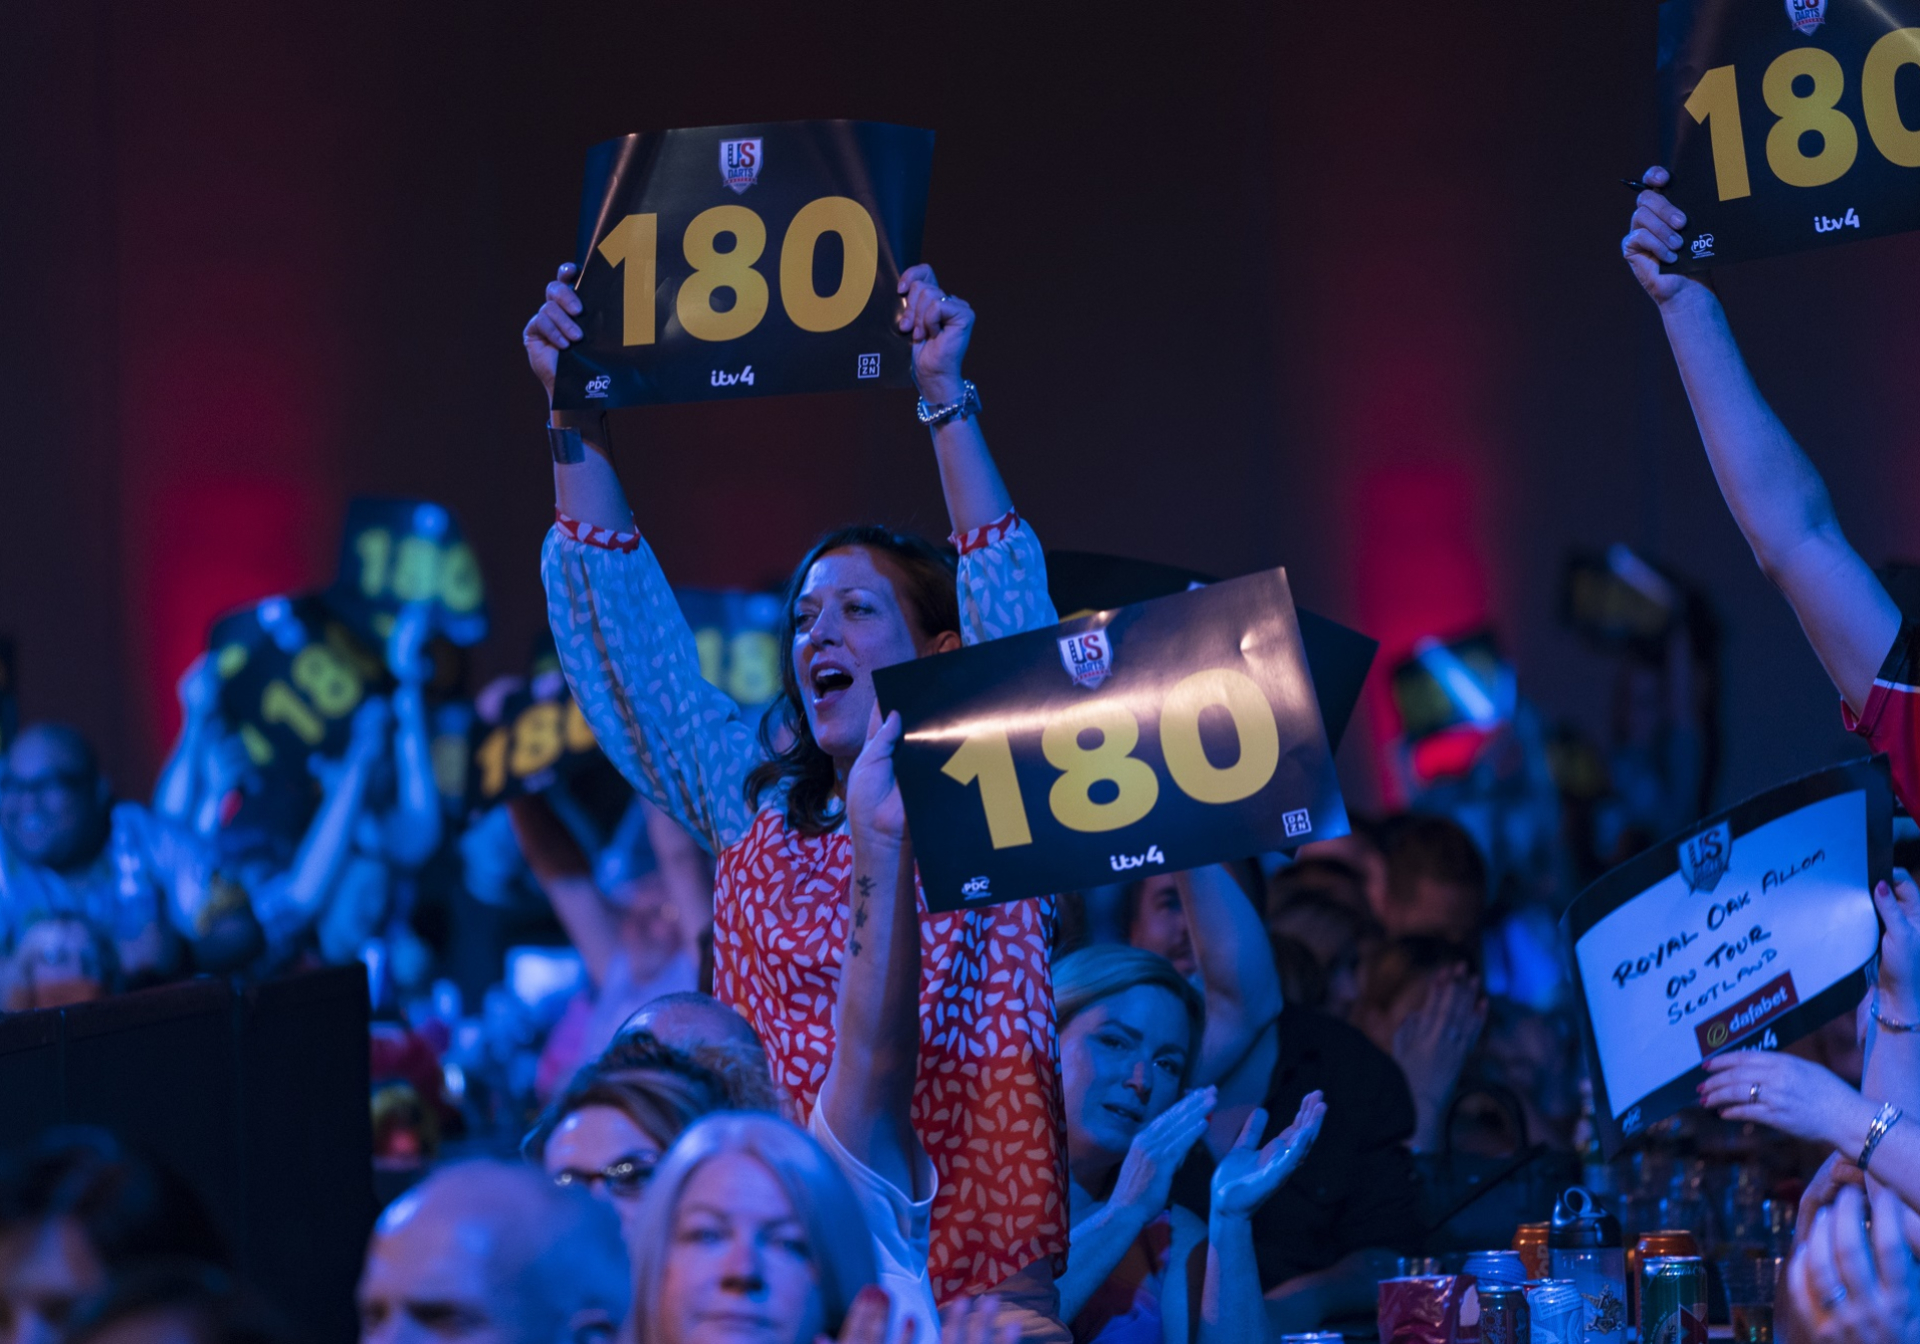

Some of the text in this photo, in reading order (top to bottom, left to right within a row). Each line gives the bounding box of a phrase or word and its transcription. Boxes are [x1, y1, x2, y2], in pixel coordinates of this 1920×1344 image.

[1683, 27, 1920, 201] 180
[727, 142, 755, 168] US
[728, 168, 754, 178] DARTS
[1813, 207, 1861, 233] itv4
[1693, 237, 1713, 250] PDC
[597, 196, 878, 347] 180
[710, 365, 755, 387] itv4
[697, 627, 781, 704] 18
[1068, 634, 1103, 664] US
[1075, 659, 1105, 675] DARTS
[939, 668, 1280, 850] 180
[1110, 845, 1164, 871] itv4
[1688, 831, 1722, 867] US
[963, 880, 989, 891] PDC
[1612, 931, 1698, 989] ROYAL
[1707, 891, 1751, 931] OAK
[1666, 925, 1772, 999] ON TOUR
[1667, 948, 1778, 1025] SCOTLAND
[1729, 986, 1788, 1033] dafabet
